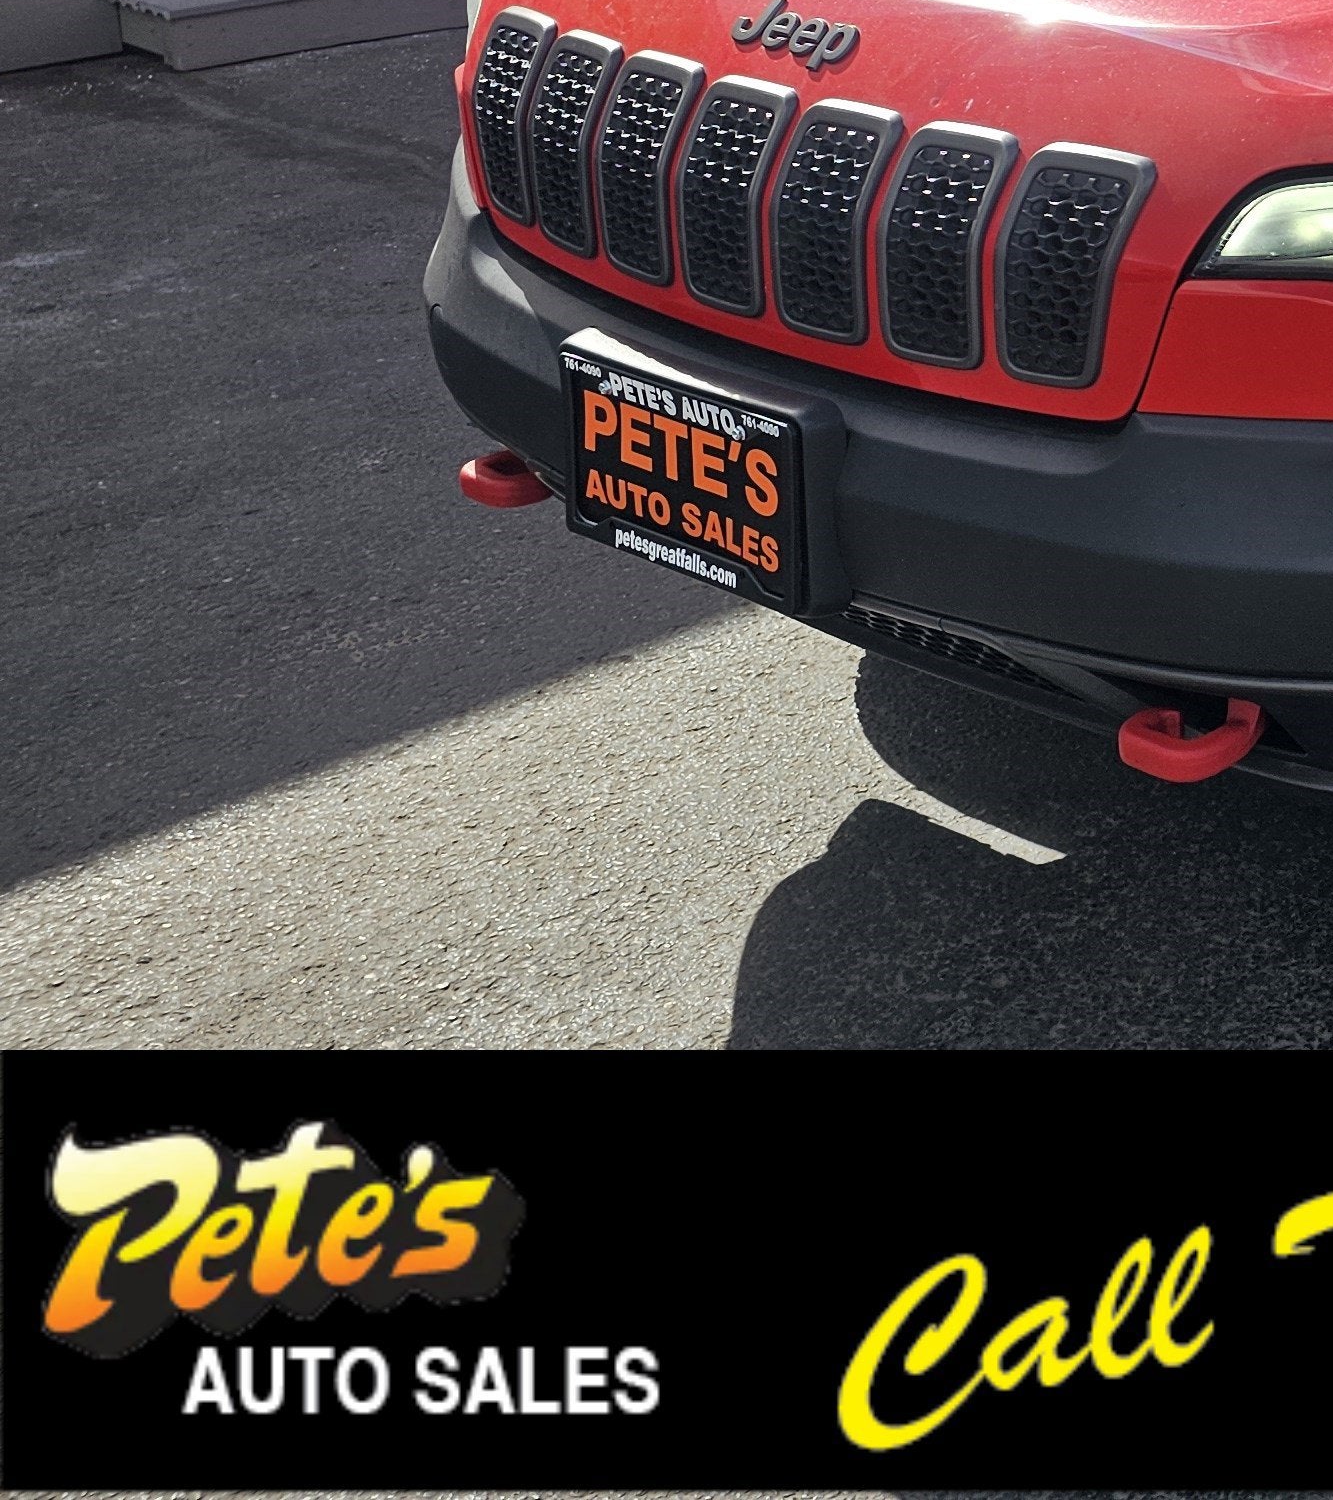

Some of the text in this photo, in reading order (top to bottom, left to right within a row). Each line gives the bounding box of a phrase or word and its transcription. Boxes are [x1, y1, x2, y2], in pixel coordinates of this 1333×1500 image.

[608, 371, 736, 435] PETE'S AUTO
[583, 389, 779, 517] PETE'S
[585, 468, 779, 573] AUTO SALES
[615, 526, 737, 589] petesgreatfalls.com
